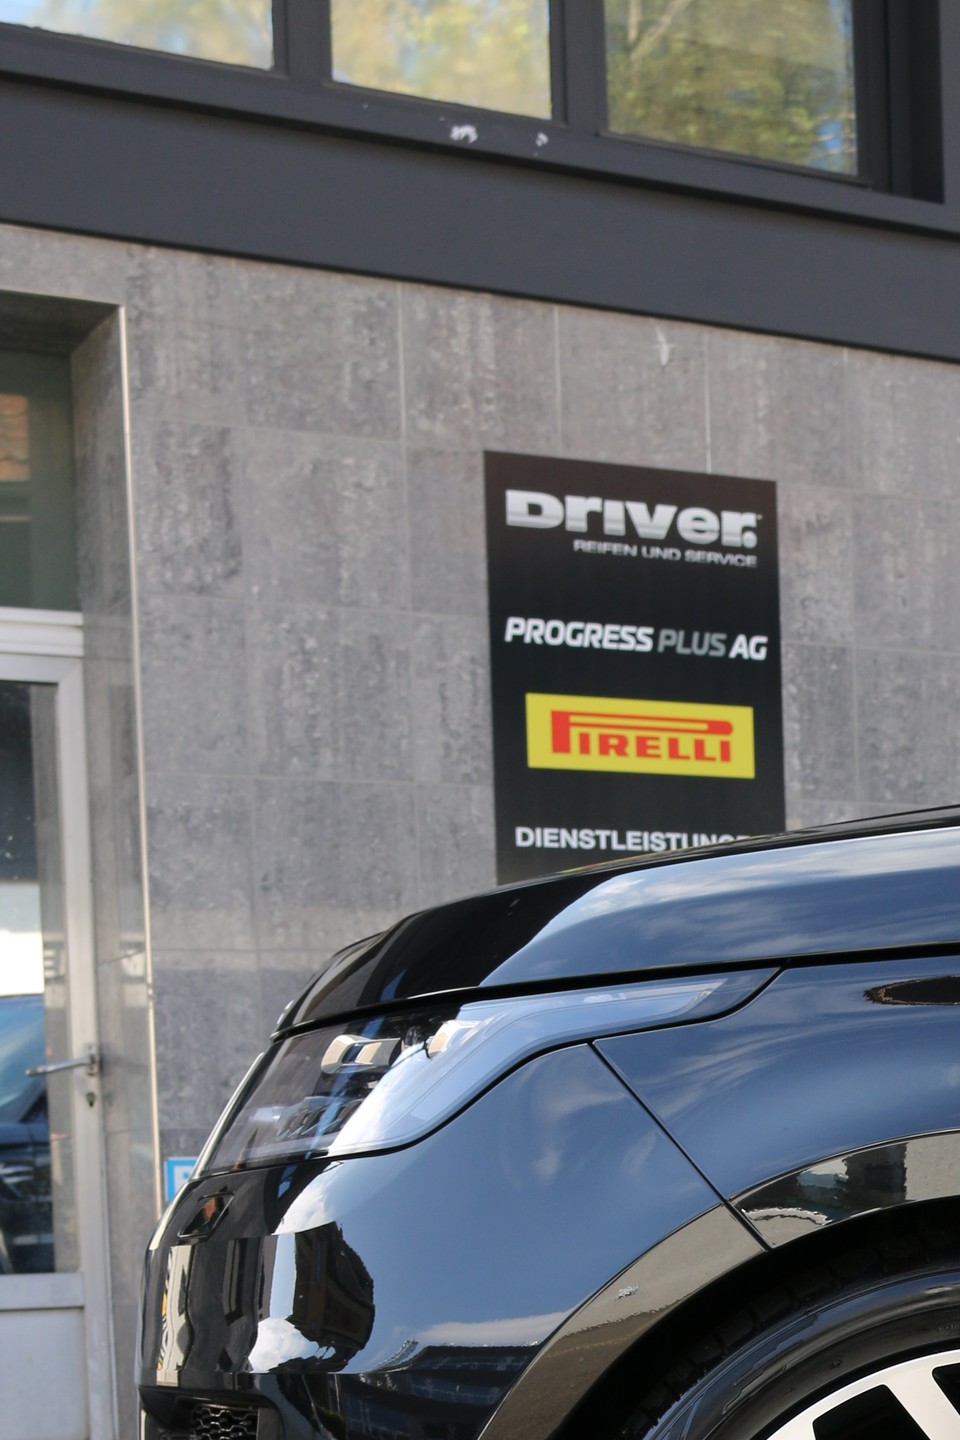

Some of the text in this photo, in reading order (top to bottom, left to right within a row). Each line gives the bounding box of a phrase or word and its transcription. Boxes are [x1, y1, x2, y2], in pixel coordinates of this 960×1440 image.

[573, 539, 758, 568] REIFEN UND SERVICE
[504, 616, 768, 660] PROGRESS PLUS AG
[550, 709, 734, 763] PIRELLI
